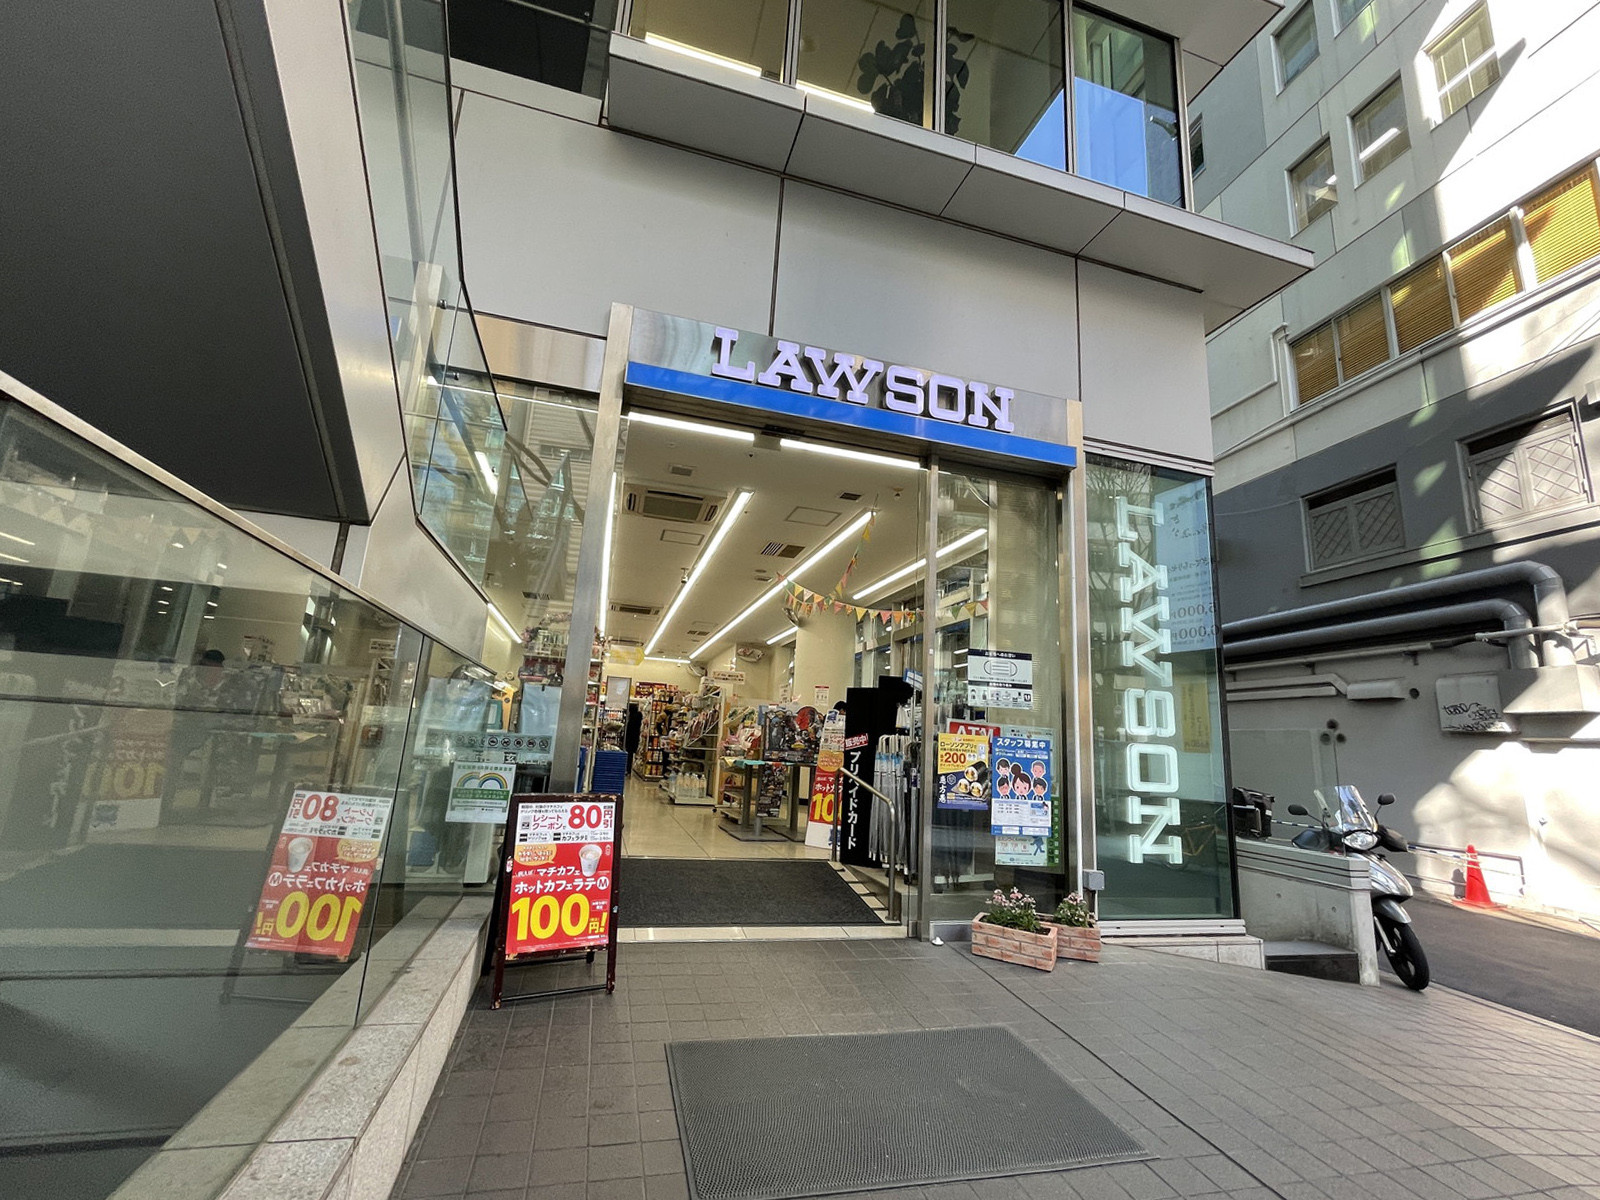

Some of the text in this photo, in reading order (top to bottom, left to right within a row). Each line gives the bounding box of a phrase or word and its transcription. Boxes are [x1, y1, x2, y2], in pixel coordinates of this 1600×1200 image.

[711, 326, 1015, 432] LAWSON
[1115, 495, 1184, 865] LAWSON
[944, 752, 967, 764] 200
[533, 814, 563, 823] レシート
[568, 804, 602, 829] 80
[537, 866, 581, 877] マチカフェ
[514, 877, 597, 895] ホットカフェラテ
[511, 893, 590, 941] 100
